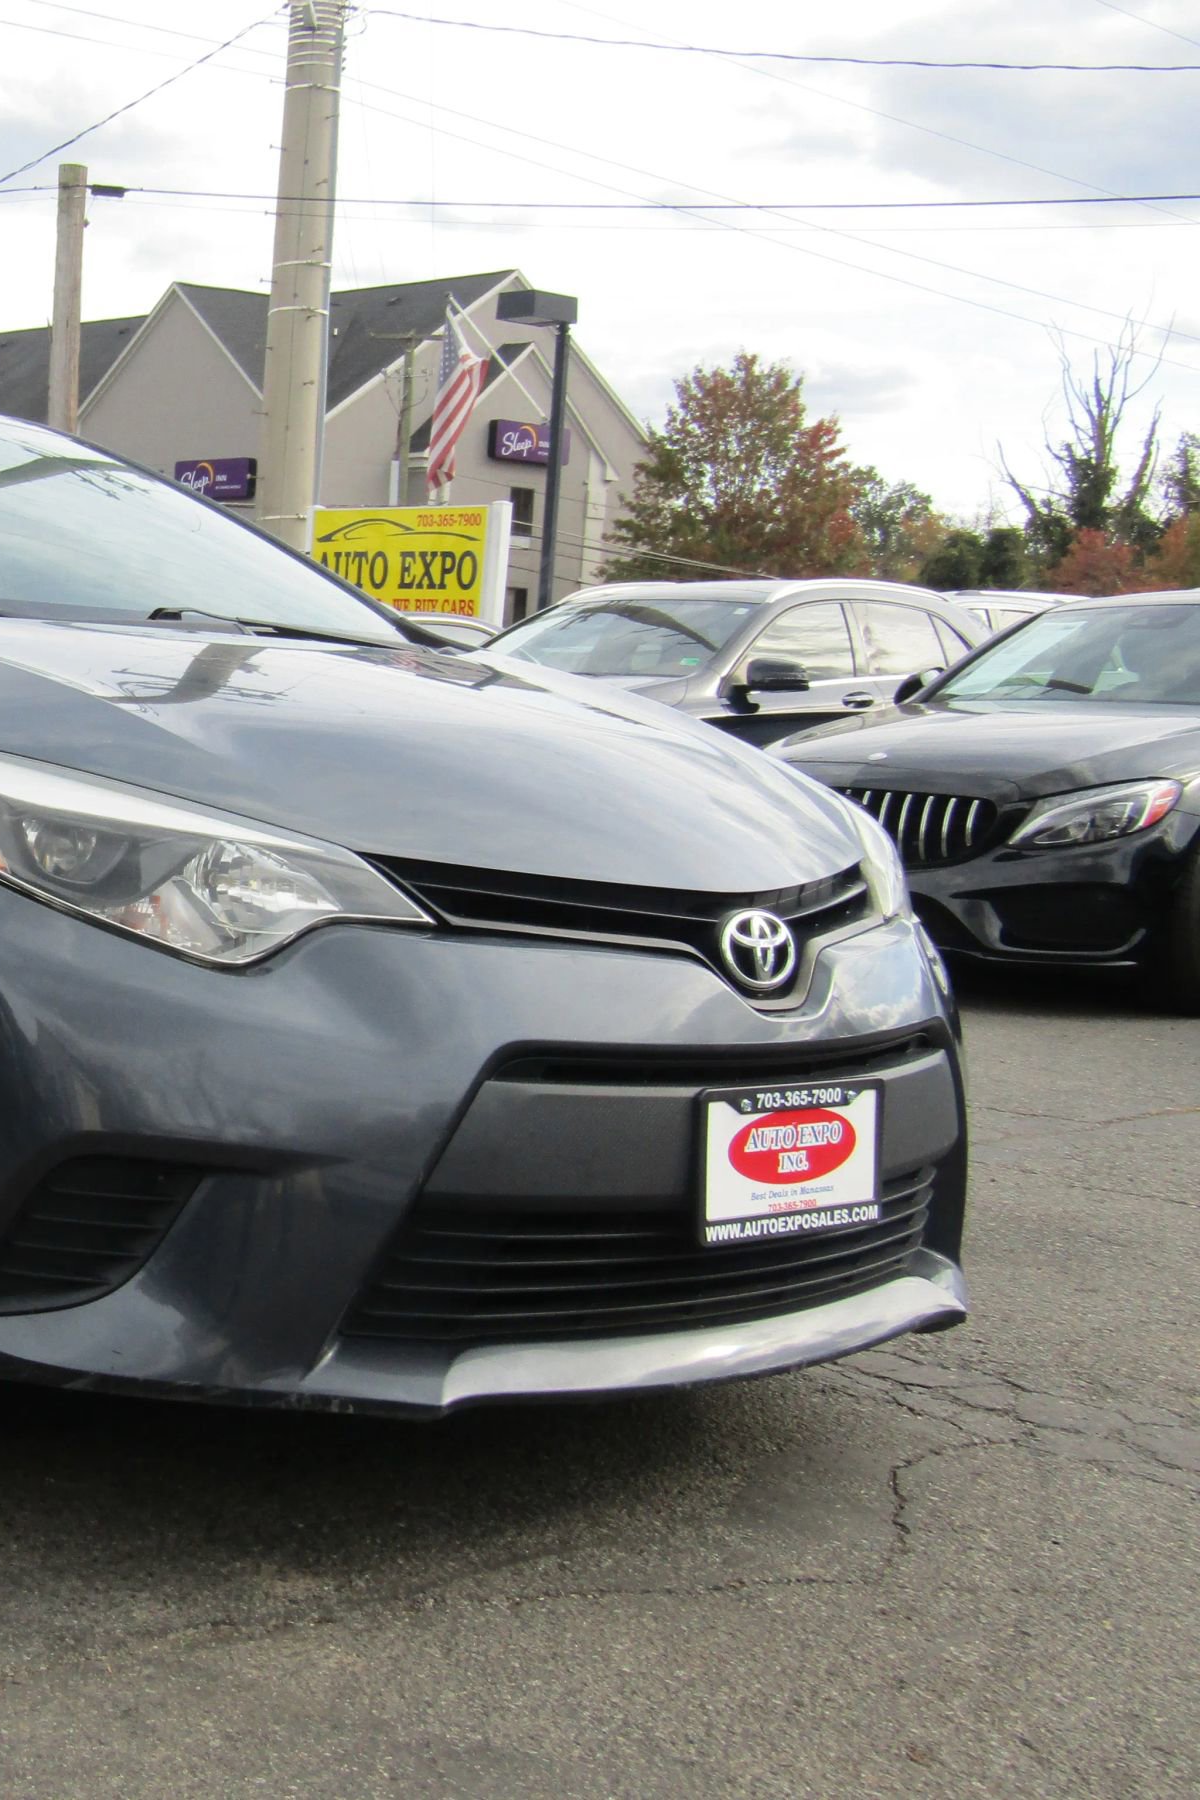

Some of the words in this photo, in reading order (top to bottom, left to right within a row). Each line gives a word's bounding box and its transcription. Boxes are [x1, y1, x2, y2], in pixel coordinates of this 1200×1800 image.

[501, 431, 532, 457] Sleep
[181, 470, 210, 495] Sleep
[416, 513, 482, 528] 703-365-7900
[397, 550, 478, 590] EXPO
[415, 599, 439, 612] BUY
[441, 599, 475, 617] CARS
[756, 1087, 842, 1109] 703-365-7900
[745, 1125, 796, 1152] AUTO
[798, 1120, 843, 1146] EXPO
[779, 1151, 809, 1173] INC.
[767, 1198, 817, 1212] 703-365-7900
[705, 1204, 879, 1242] WWW.AUTOEXPOSALES.COM
